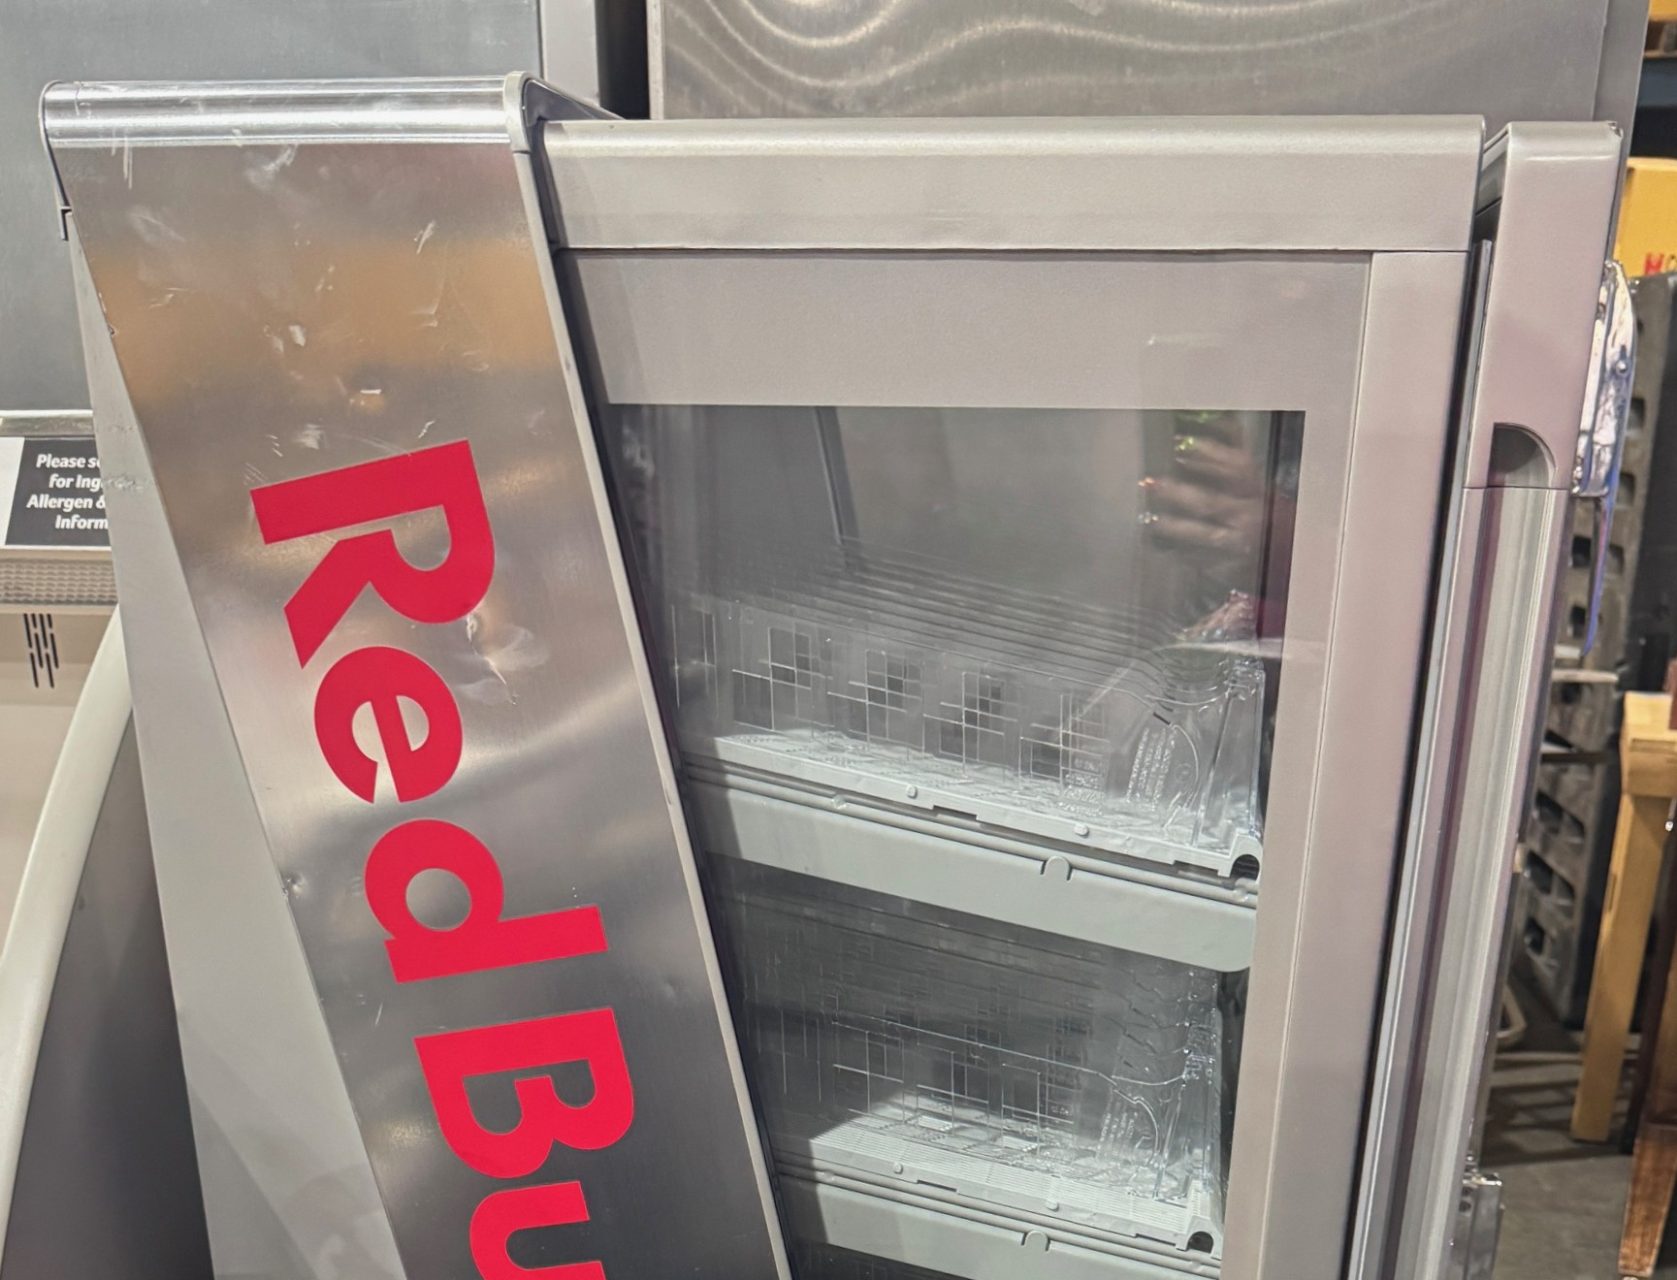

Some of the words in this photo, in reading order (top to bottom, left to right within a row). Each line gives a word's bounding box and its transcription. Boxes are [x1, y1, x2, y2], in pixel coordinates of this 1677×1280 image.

[36, 453, 86, 468] Please
[48, 473, 74, 488] for
[75, 474, 103, 492] Ing
[26, 494, 93, 512] Allergen
[250, 438, 608, 983] Red
